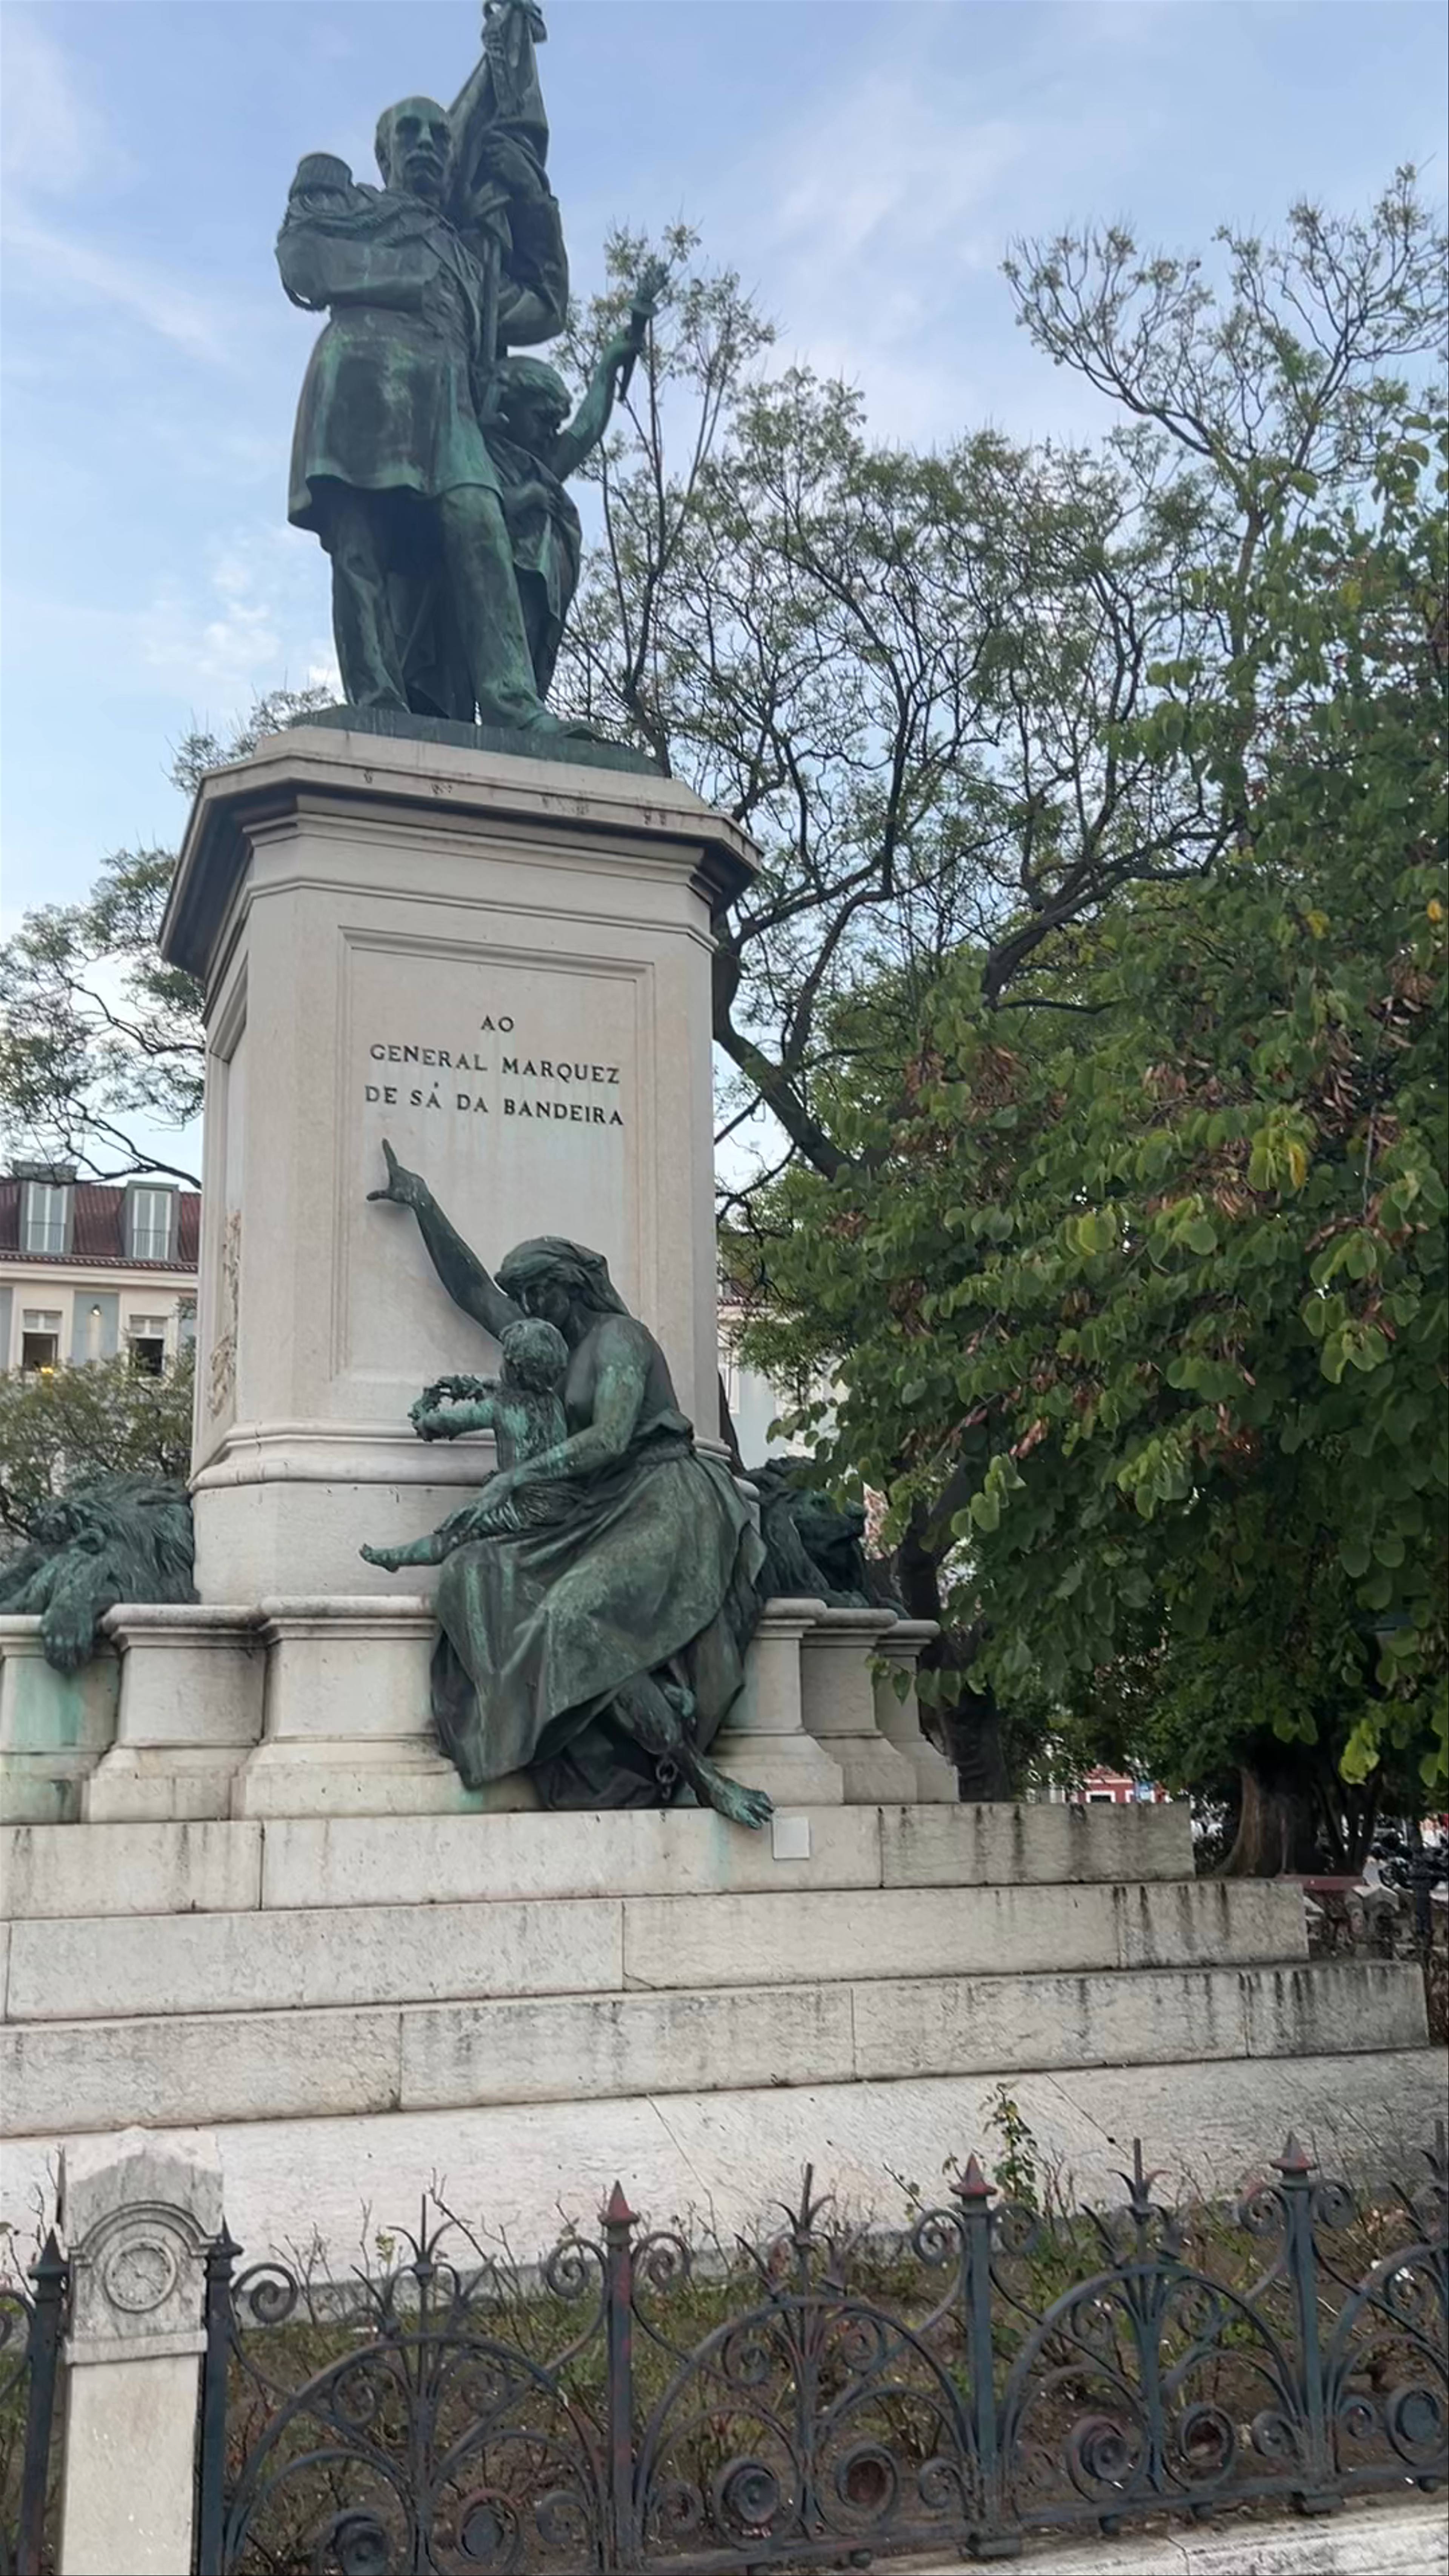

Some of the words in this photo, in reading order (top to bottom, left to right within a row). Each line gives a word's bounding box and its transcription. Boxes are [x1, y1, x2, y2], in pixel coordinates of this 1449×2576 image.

[480, 1015, 514, 1033] AO
[370, 1044, 488, 1071] GENERAL
[502, 1057, 620, 1085] MARQUEZ
[365, 1086, 398, 1105] DE
[410, 1081, 441, 1109] SÁ
[457, 1093, 489, 1113] DA
[504, 1098, 624, 1126] BANDEIRA
